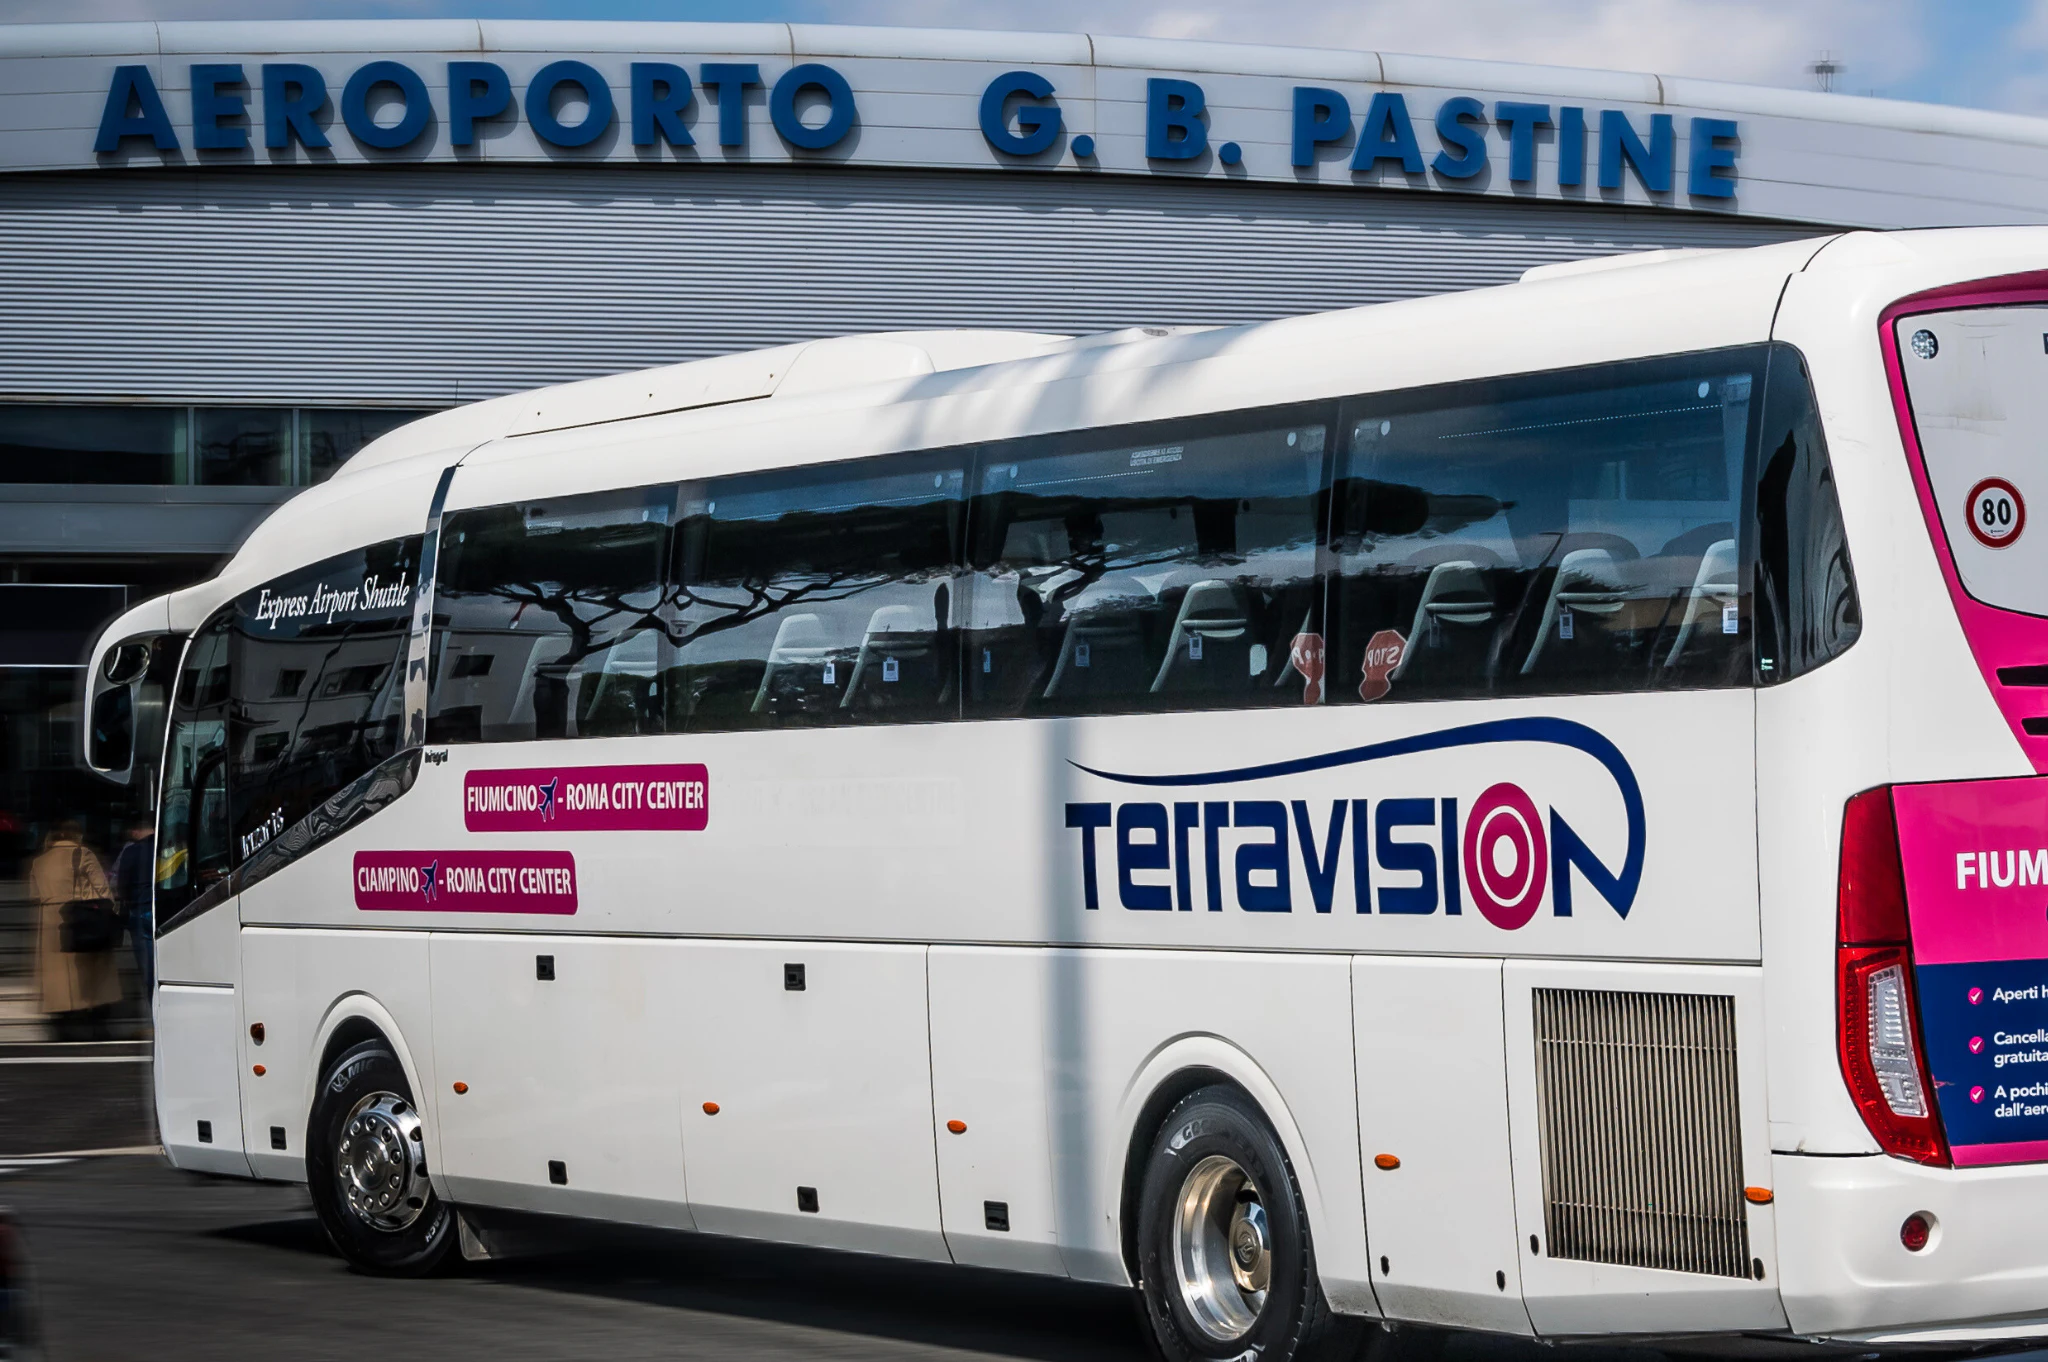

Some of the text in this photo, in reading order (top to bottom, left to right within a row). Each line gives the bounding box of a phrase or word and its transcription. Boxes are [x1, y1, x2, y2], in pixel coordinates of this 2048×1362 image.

[93, 60, 1739, 198] AEROPORTO G. B. PASTINE
[1982, 498, 2012, 526] 80
[255, 572, 410, 630] Express Airport Shuttle
[467, 784, 538, 812] FIUMICINO
[566, 783, 609, 811] ROMA
[611, 782, 645, 810] CITY
[647, 781, 704, 809] CENTER
[358, 867, 419, 892] CIAMPINO
[446, 867, 486, 893] ROMA
[488, 868, 516, 893] CITY
[520, 868, 572, 894] CENTER
[1956, 849, 2048, 890] FIUM
[1992, 985, 2038, 1004] Aperti
[1993, 1048, 2048, 1068] gratuita
[1994, 1081, 2048, 1101] A pochi
